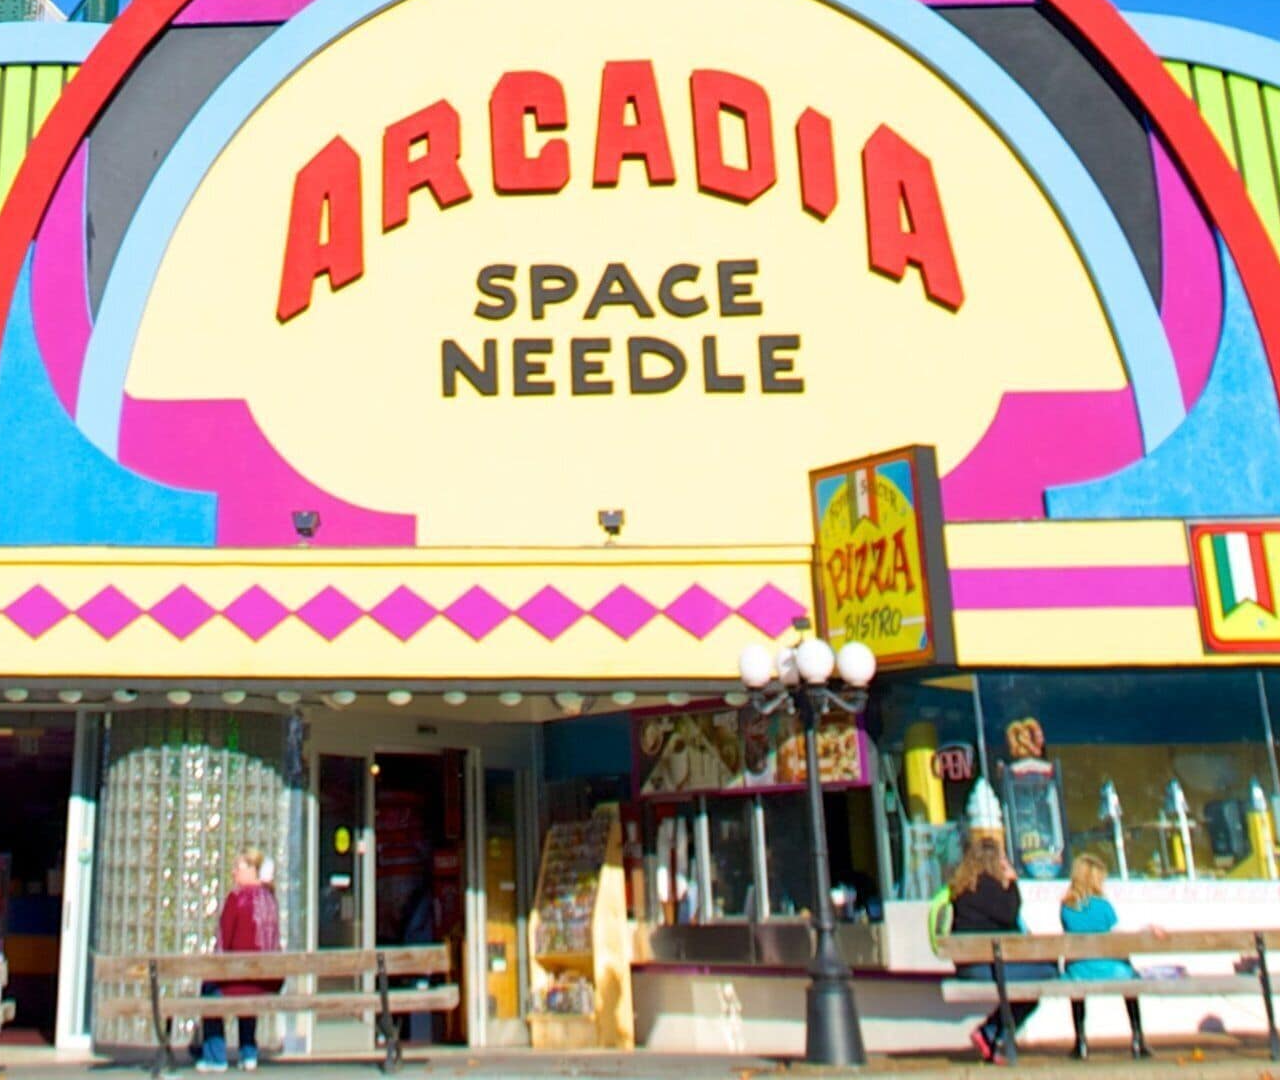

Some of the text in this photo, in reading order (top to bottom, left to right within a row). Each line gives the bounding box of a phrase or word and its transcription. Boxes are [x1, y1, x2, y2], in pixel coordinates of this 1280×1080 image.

[276, 58, 967, 325] ARCADIA
[474, 258, 764, 321] SPACE
[441, 334, 806, 398] NEEDLE
[826, 527, 916, 611] PIZZA
[843, 603, 903, 642] BISTRO
[931, 747, 973, 782] OPEN
